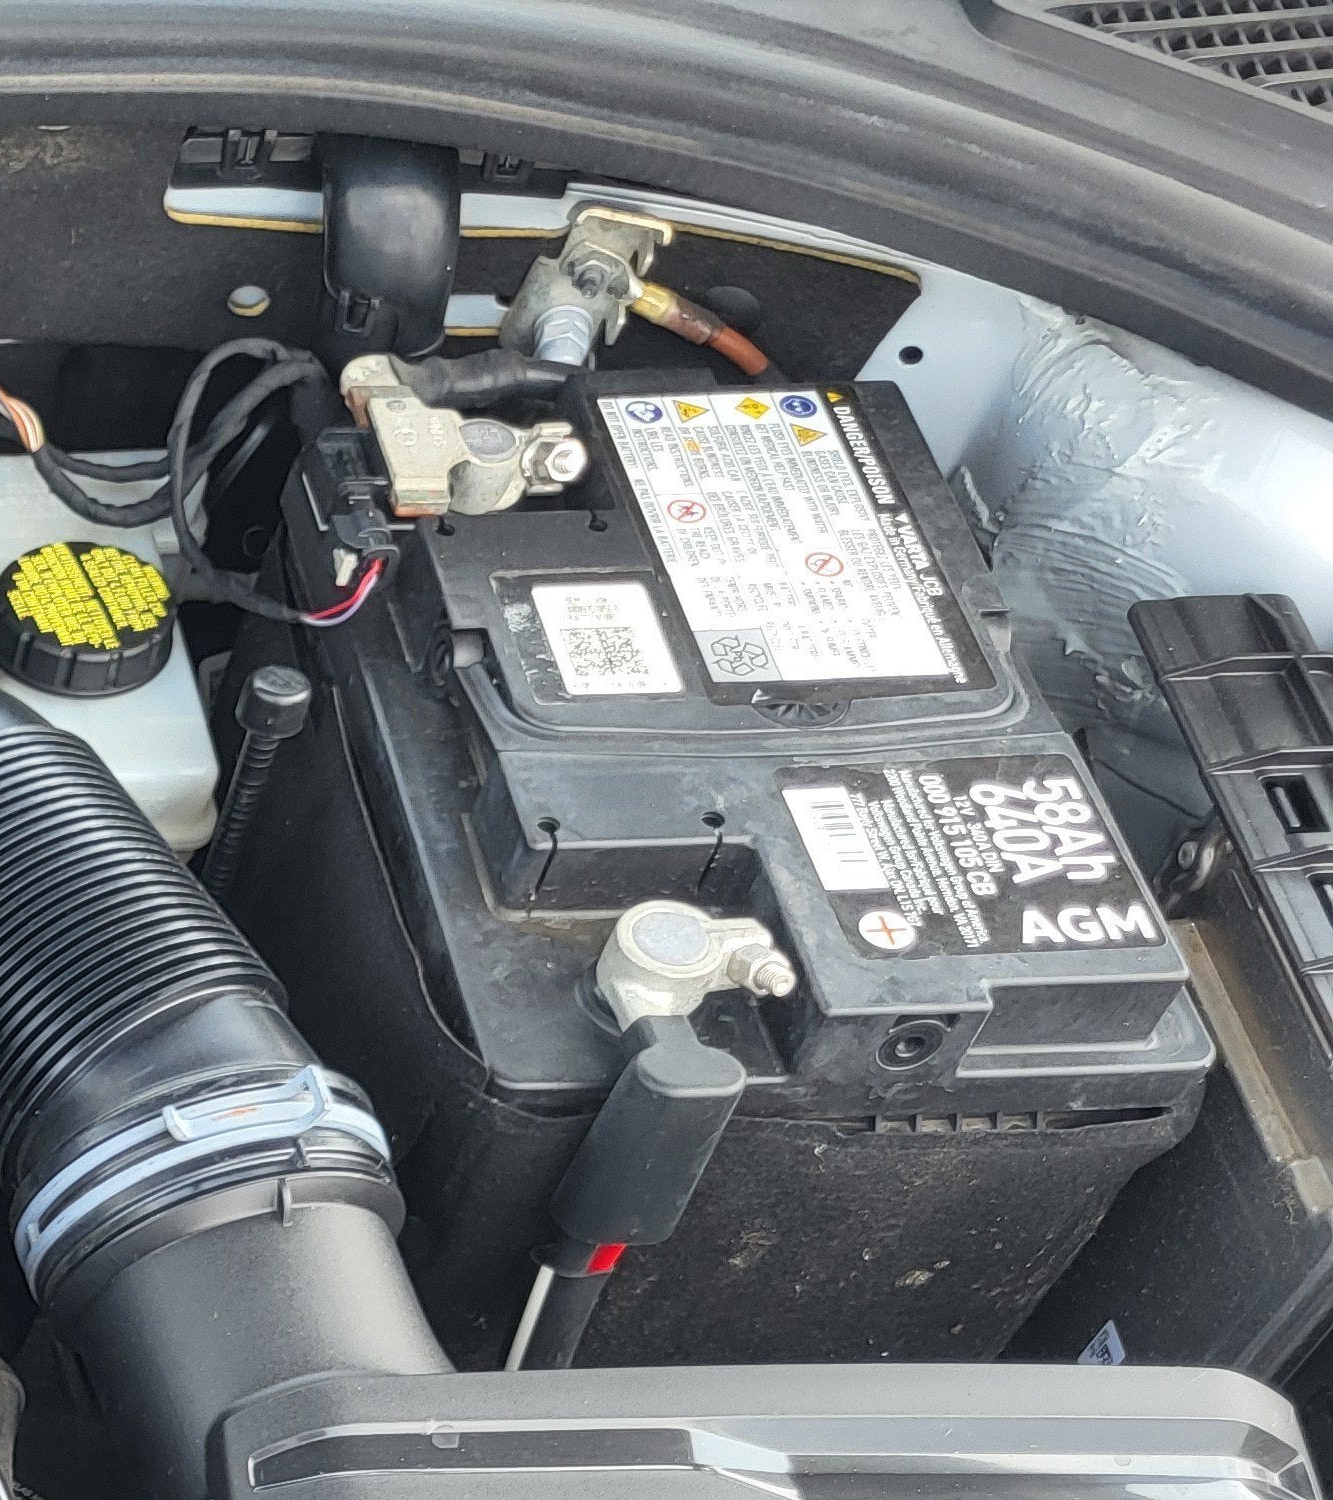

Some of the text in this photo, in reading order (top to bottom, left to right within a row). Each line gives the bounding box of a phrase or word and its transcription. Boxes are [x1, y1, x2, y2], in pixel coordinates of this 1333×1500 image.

[833, 405, 885, 505] DANGER/POISON
[875, 513, 894, 537] Made
[886, 537, 898, 547] in
[897, 523, 945, 597] VARTA JCB
[928, 624, 944, 636] en
[933, 636, 969, 686] Allemagne
[914, 774, 999, 897] 000 915 105 CB
[950, 795, 975, 816] 12V
[978, 850, 1005, 873] DIN
[964, 781, 1070, 884] 640A
[1017, 776, 1125, 881] 58Ah
[1021, 903, 1157, 945] AGM
